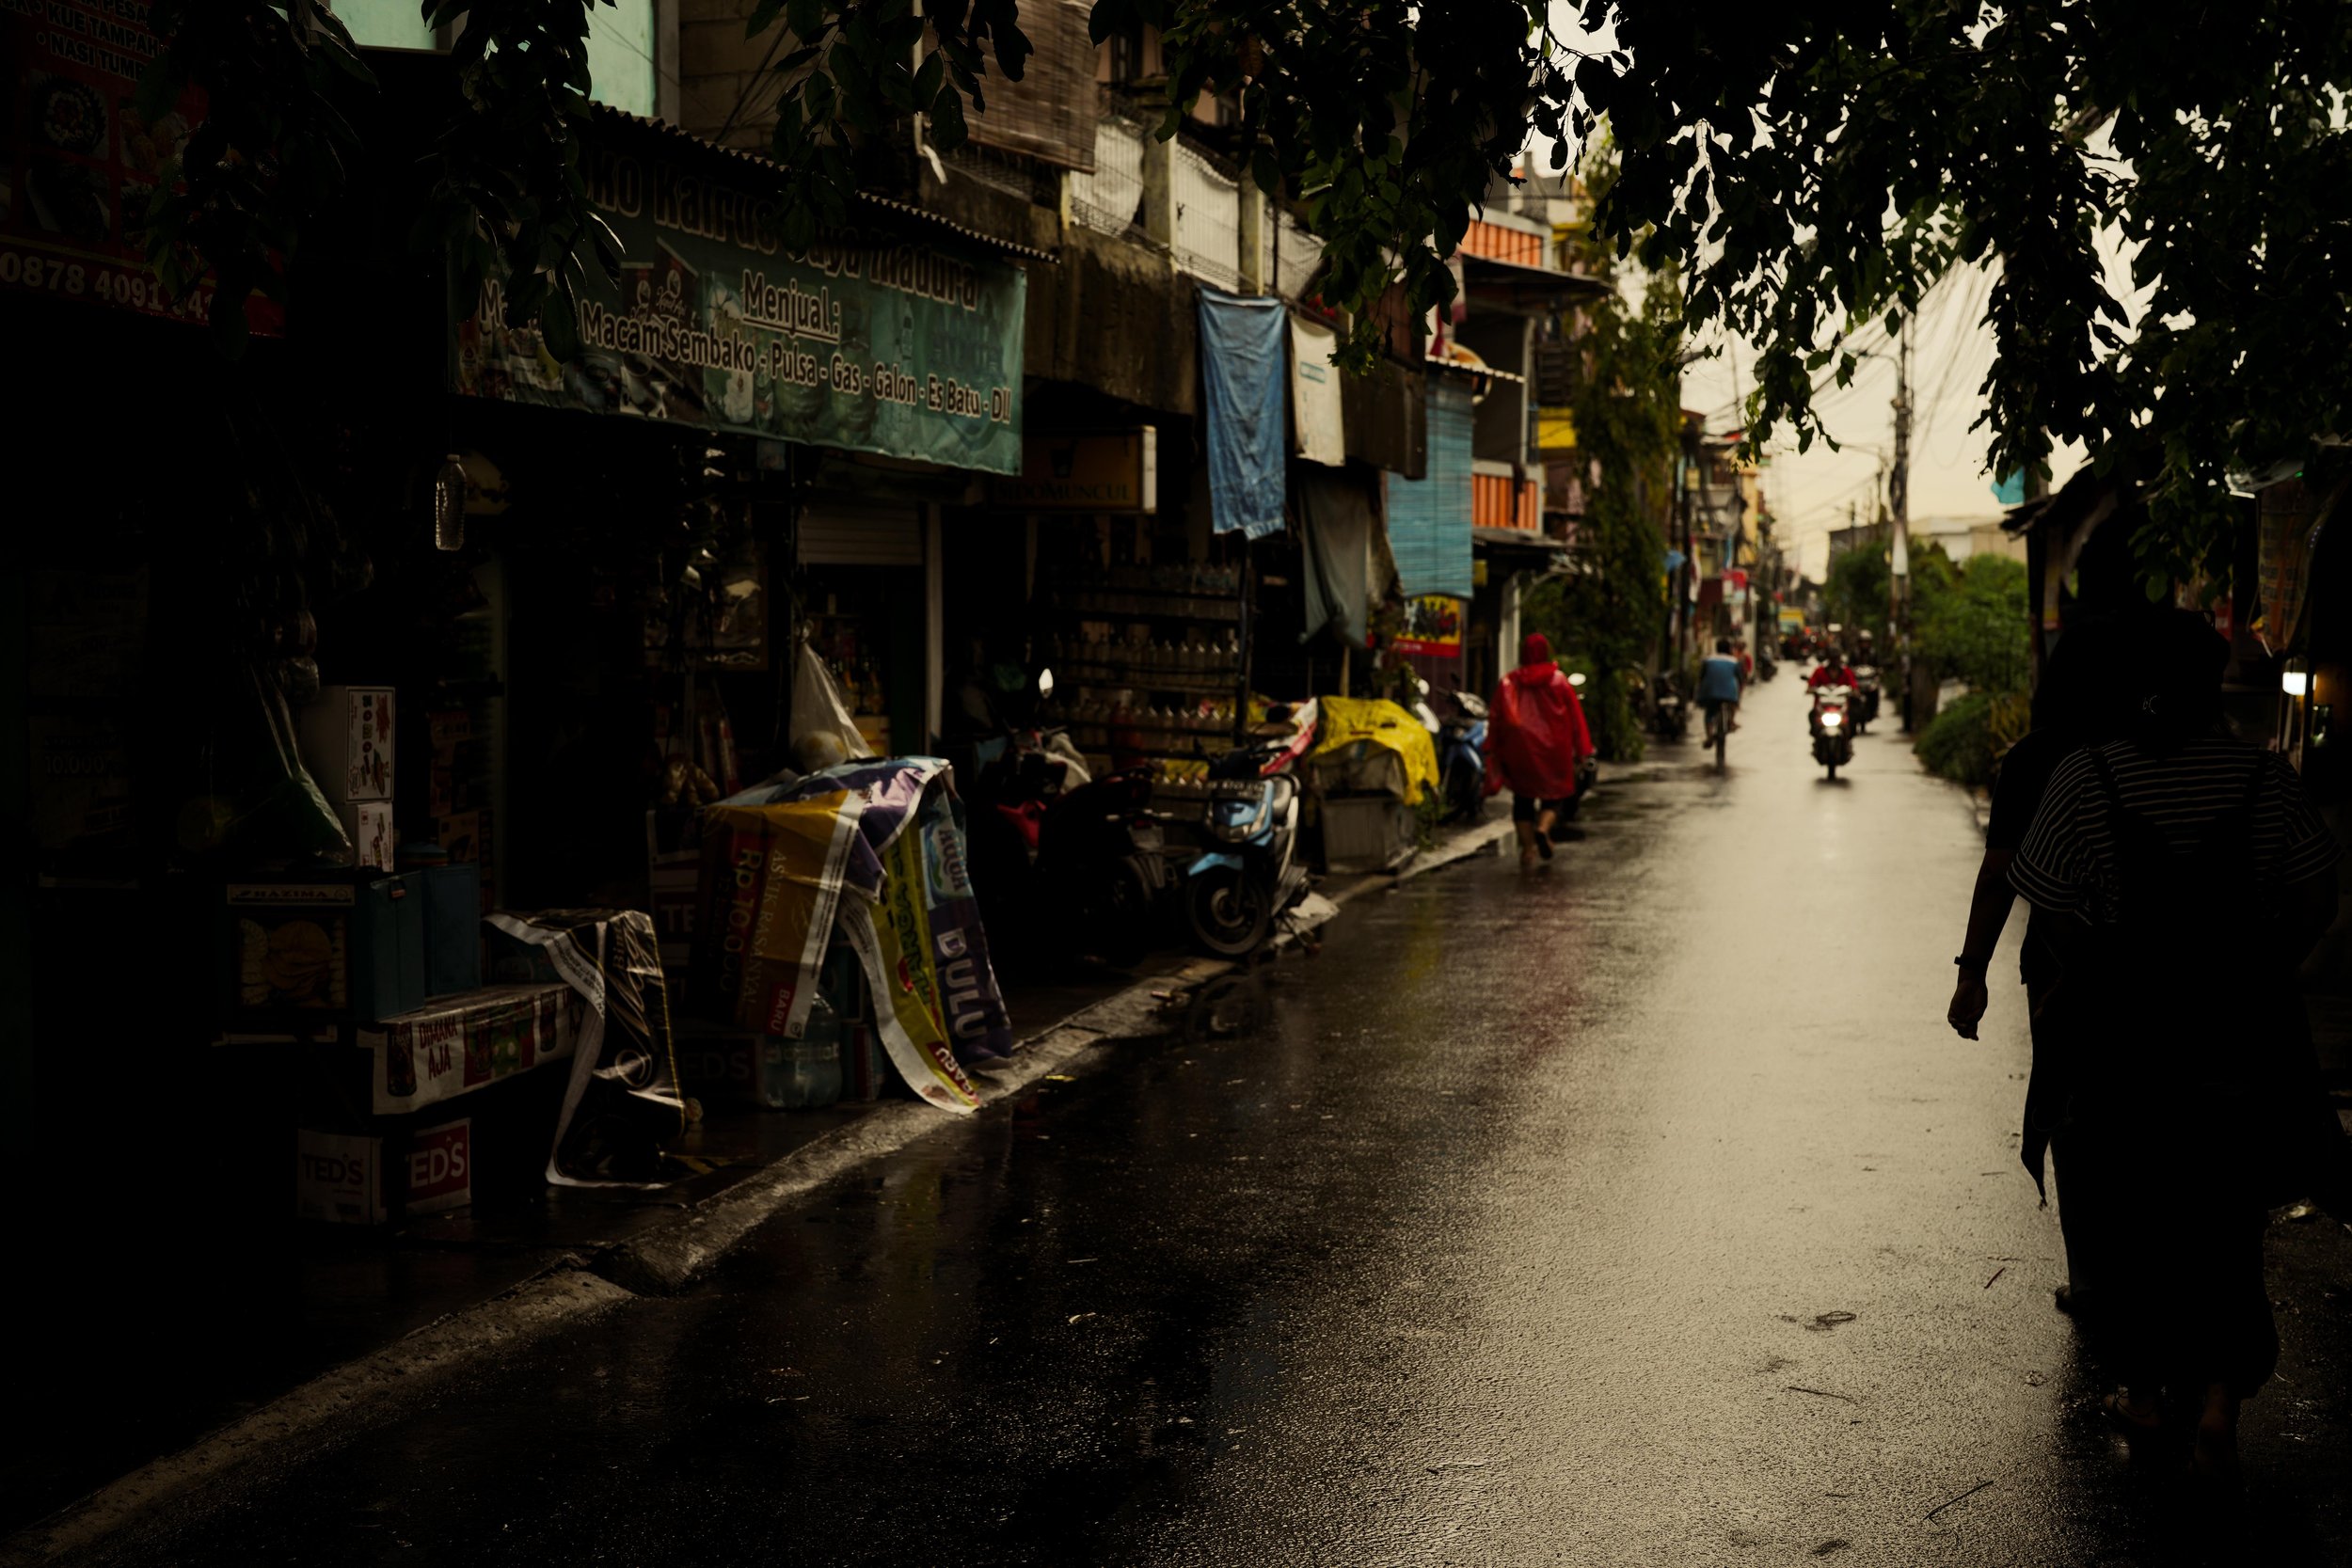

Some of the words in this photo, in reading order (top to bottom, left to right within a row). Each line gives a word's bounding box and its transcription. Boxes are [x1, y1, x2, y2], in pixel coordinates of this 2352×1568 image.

[49, 31, 96, 67] NASI
[0, 251, 86, 295] 0878
[580, 299, 665, 356] Macam
[664, 320, 755, 374] Sembako
[771, 341, 818, 387] Pulsa
[831, 353, 862, 394] Gas
[872, 362, 917, 405] Galon
[928, 373, 944, 411] Es
[946, 378, 981, 419] Batu
[730, 847, 766, 890] Rp
[936, 927, 989, 1041] DULU
[769, 988, 792, 1033] BARU
[420, 1016, 458, 1049] DIMANA
[429, 1045, 452, 1081] AJA
